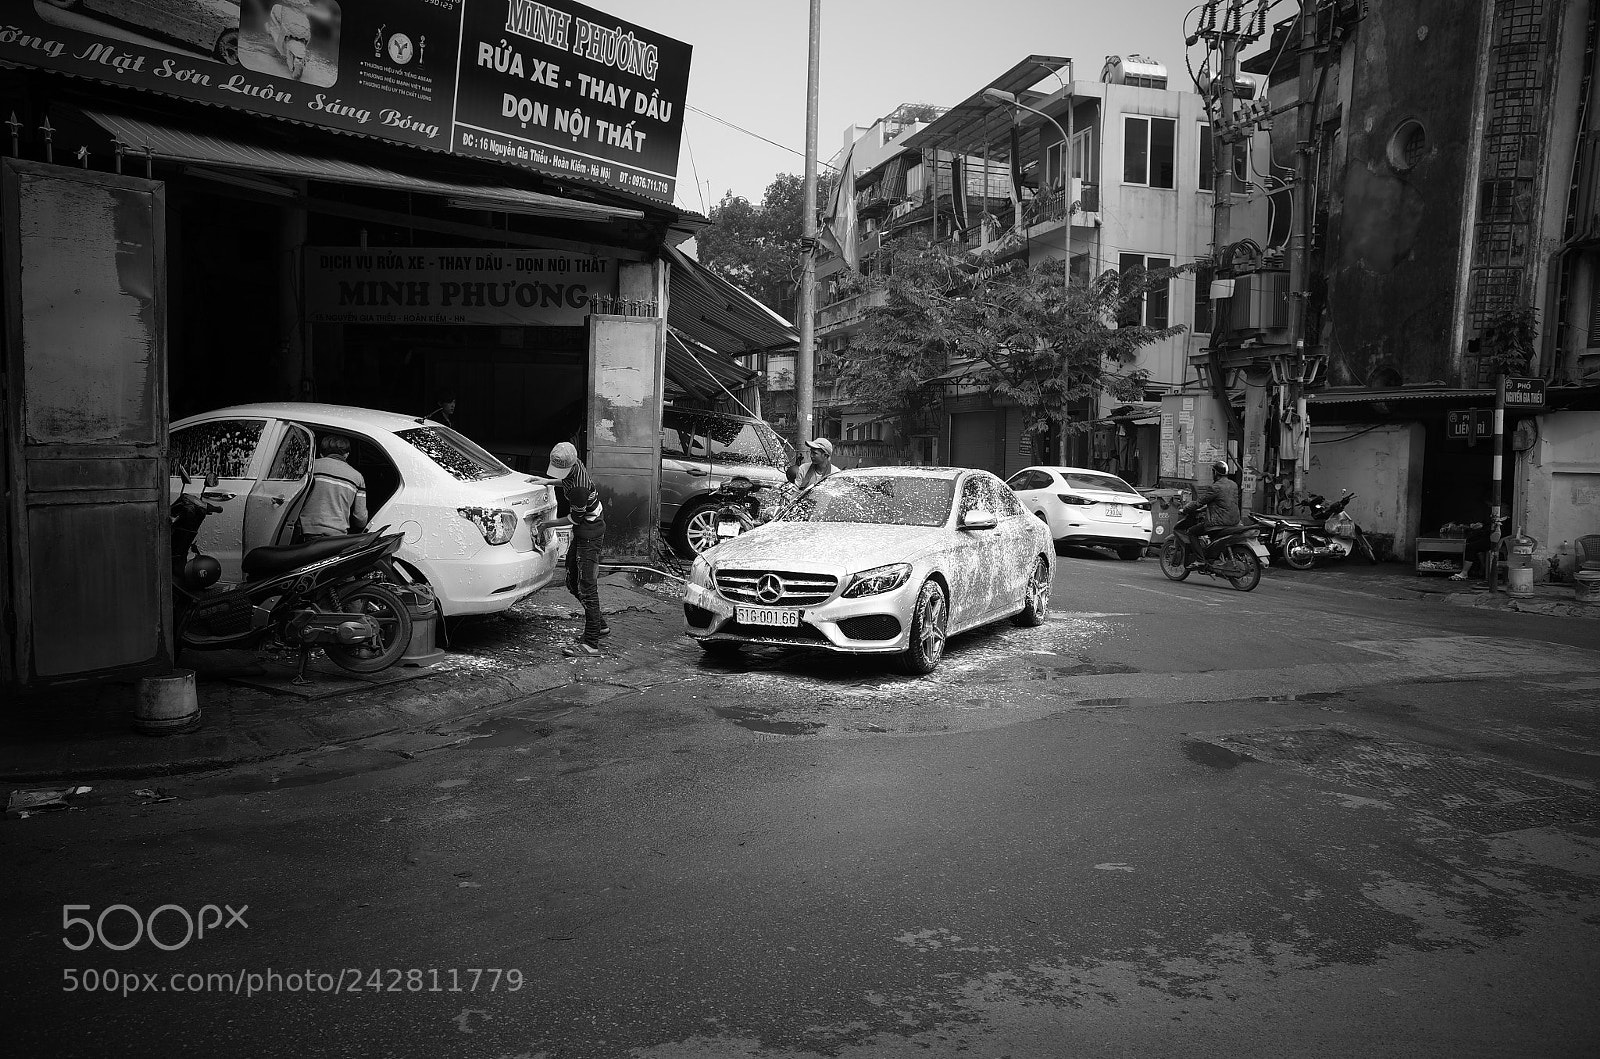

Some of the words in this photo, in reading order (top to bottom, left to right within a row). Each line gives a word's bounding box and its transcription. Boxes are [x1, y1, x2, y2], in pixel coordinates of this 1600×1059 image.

[505, 0, 571, 51] MINH
[573, 17, 658, 81] PHƯƠNG
[0, 25, 67, 57] ỡng
[73, 43, 146, 74] Mặt
[153, 59, 212, 87] Sơn
[218, 74, 293, 104] Luôn
[307, 93, 372, 124] Sáng
[379, 108, 440, 139] Bóng
[477, 38, 524, 78] RỬA
[530, 58, 560, 88] XE
[578, 73, 631, 109] THAY
[634, 88, 672, 122] DẦU
[502, 93, 549, 129] DỌN
[554, 108, 591, 142] NỘI
[596, 120, 646, 153] THẤT
[480, 137, 488, 150] 16
[489, 141, 516, 157] Nguyễn
[517, 146, 529, 159] Gia
[552, 155, 569, 170] Hoàn
[570, 158, 586, 174] Kiếm
[590, 164, 600, 177] Hà
[600, 166, 611, 182] Nội
[355, 255, 373, 272] VỤ
[377, 250, 404, 270] RỬA
[408, 255, 425, 270] XE
[438, 256, 472, 271] THAY
[475, 252, 502, 271] DẦU
[515, 257, 544, 275] DỌN
[548, 255, 571, 275] NỘI
[575, 254, 608, 273] THẤT
[338, 281, 430, 307] MINH
[440, 280, 590, 309] PHƯƠNG
[360, 314, 374, 322] GIA
[1517, 380, 1532, 389] PHỐ
